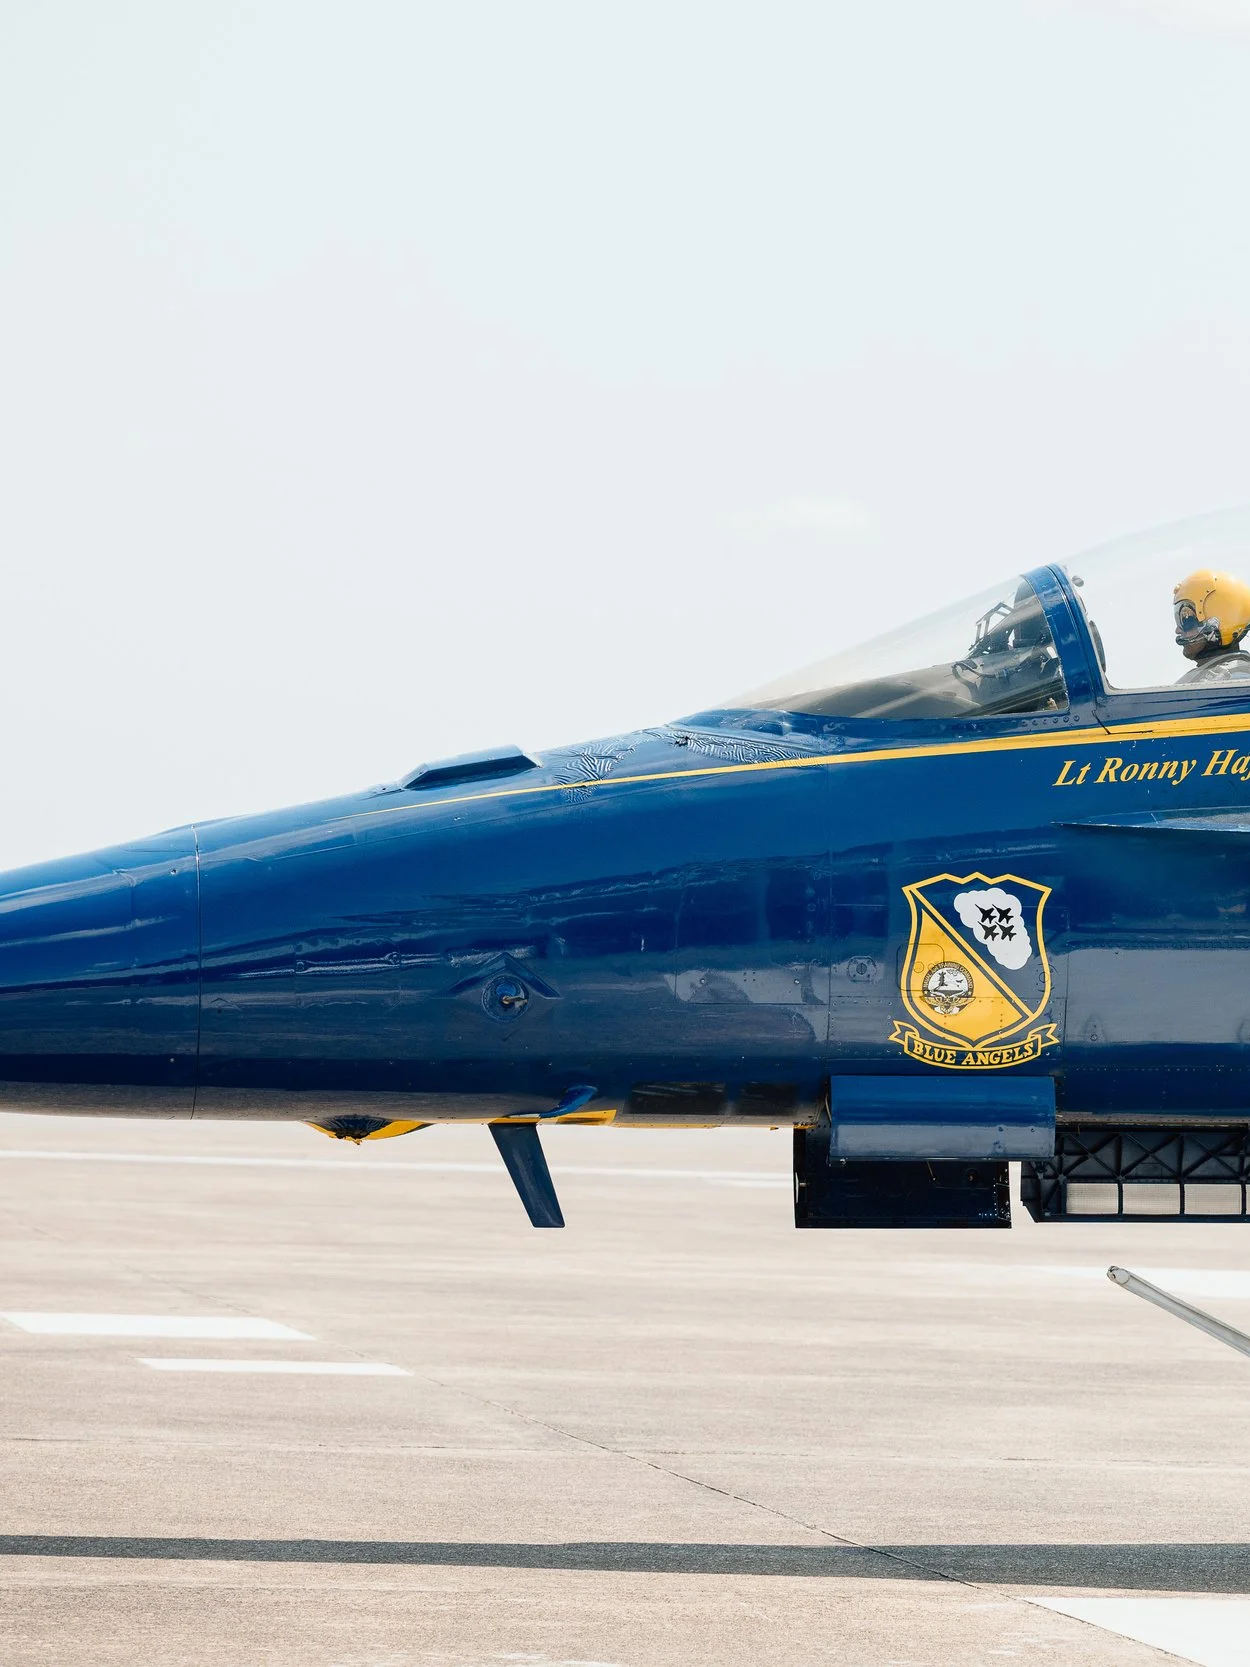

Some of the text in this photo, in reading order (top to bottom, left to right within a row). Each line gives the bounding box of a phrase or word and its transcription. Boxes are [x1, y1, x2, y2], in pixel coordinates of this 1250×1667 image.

[1053, 759, 1092, 786] Lt
[1094, 757, 1197, 786] Ronny
[913, 1040, 1034, 1066] BLUE ANGELS
